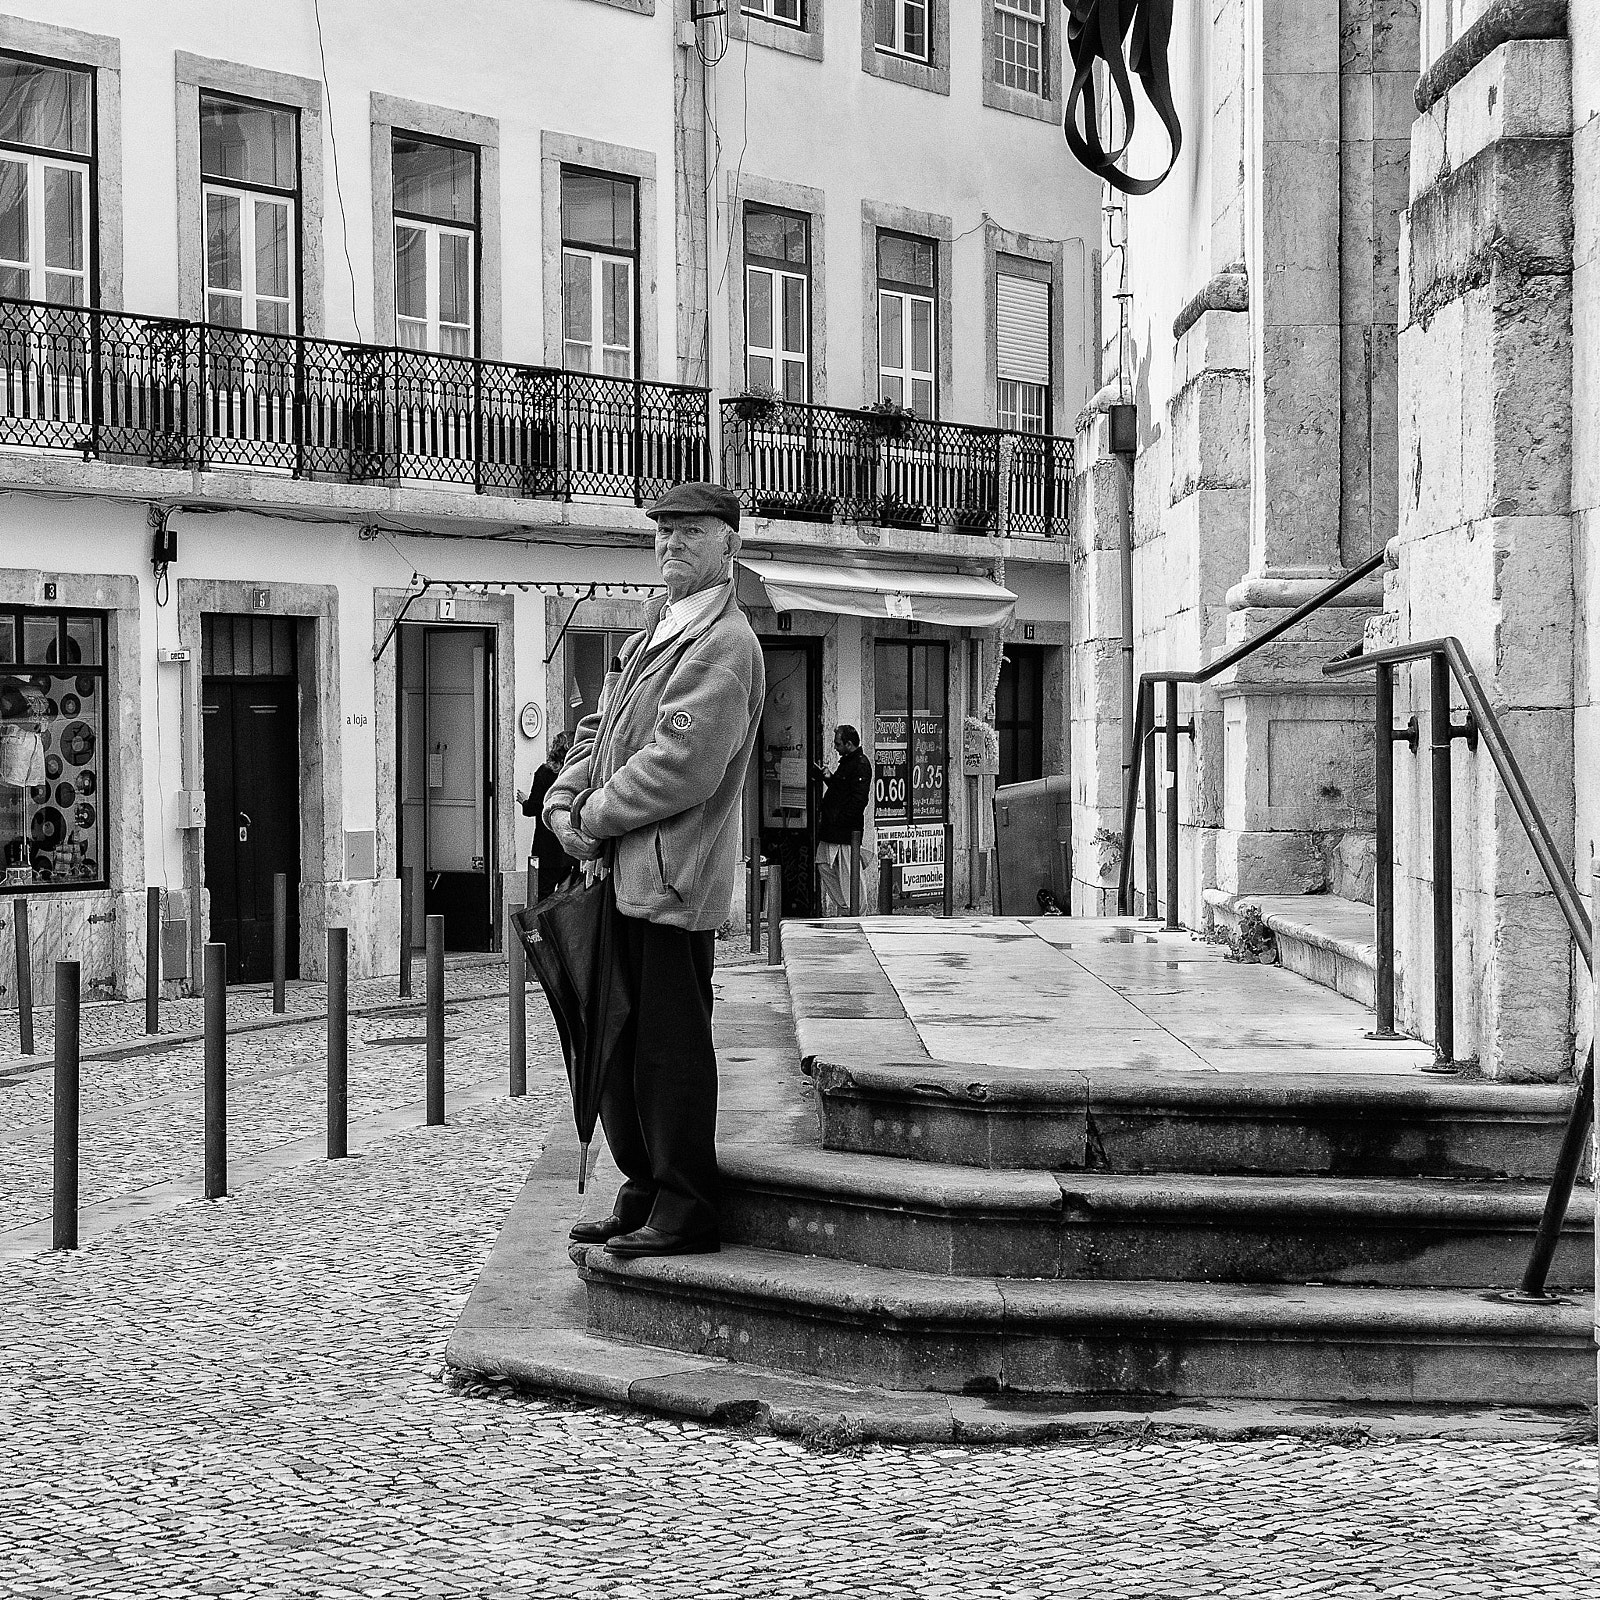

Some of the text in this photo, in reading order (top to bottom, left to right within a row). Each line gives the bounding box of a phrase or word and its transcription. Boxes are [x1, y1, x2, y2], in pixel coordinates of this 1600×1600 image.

[49, 585, 55, 598] 3
[259, 592, 266, 607] 5
[445, 601, 451, 616] 7
[346, 713, 368, 728] a loja
[875, 717, 906, 738] Cerveja
[912, 720, 937, 734] Water
[912, 765, 943, 789] 0.35
[876, 778, 906, 802] 0.60
[890, 830, 915, 839] MERCADO
[915, 829, 944, 838] PASTELARIA
[903, 871, 943, 887] Lycamobile
